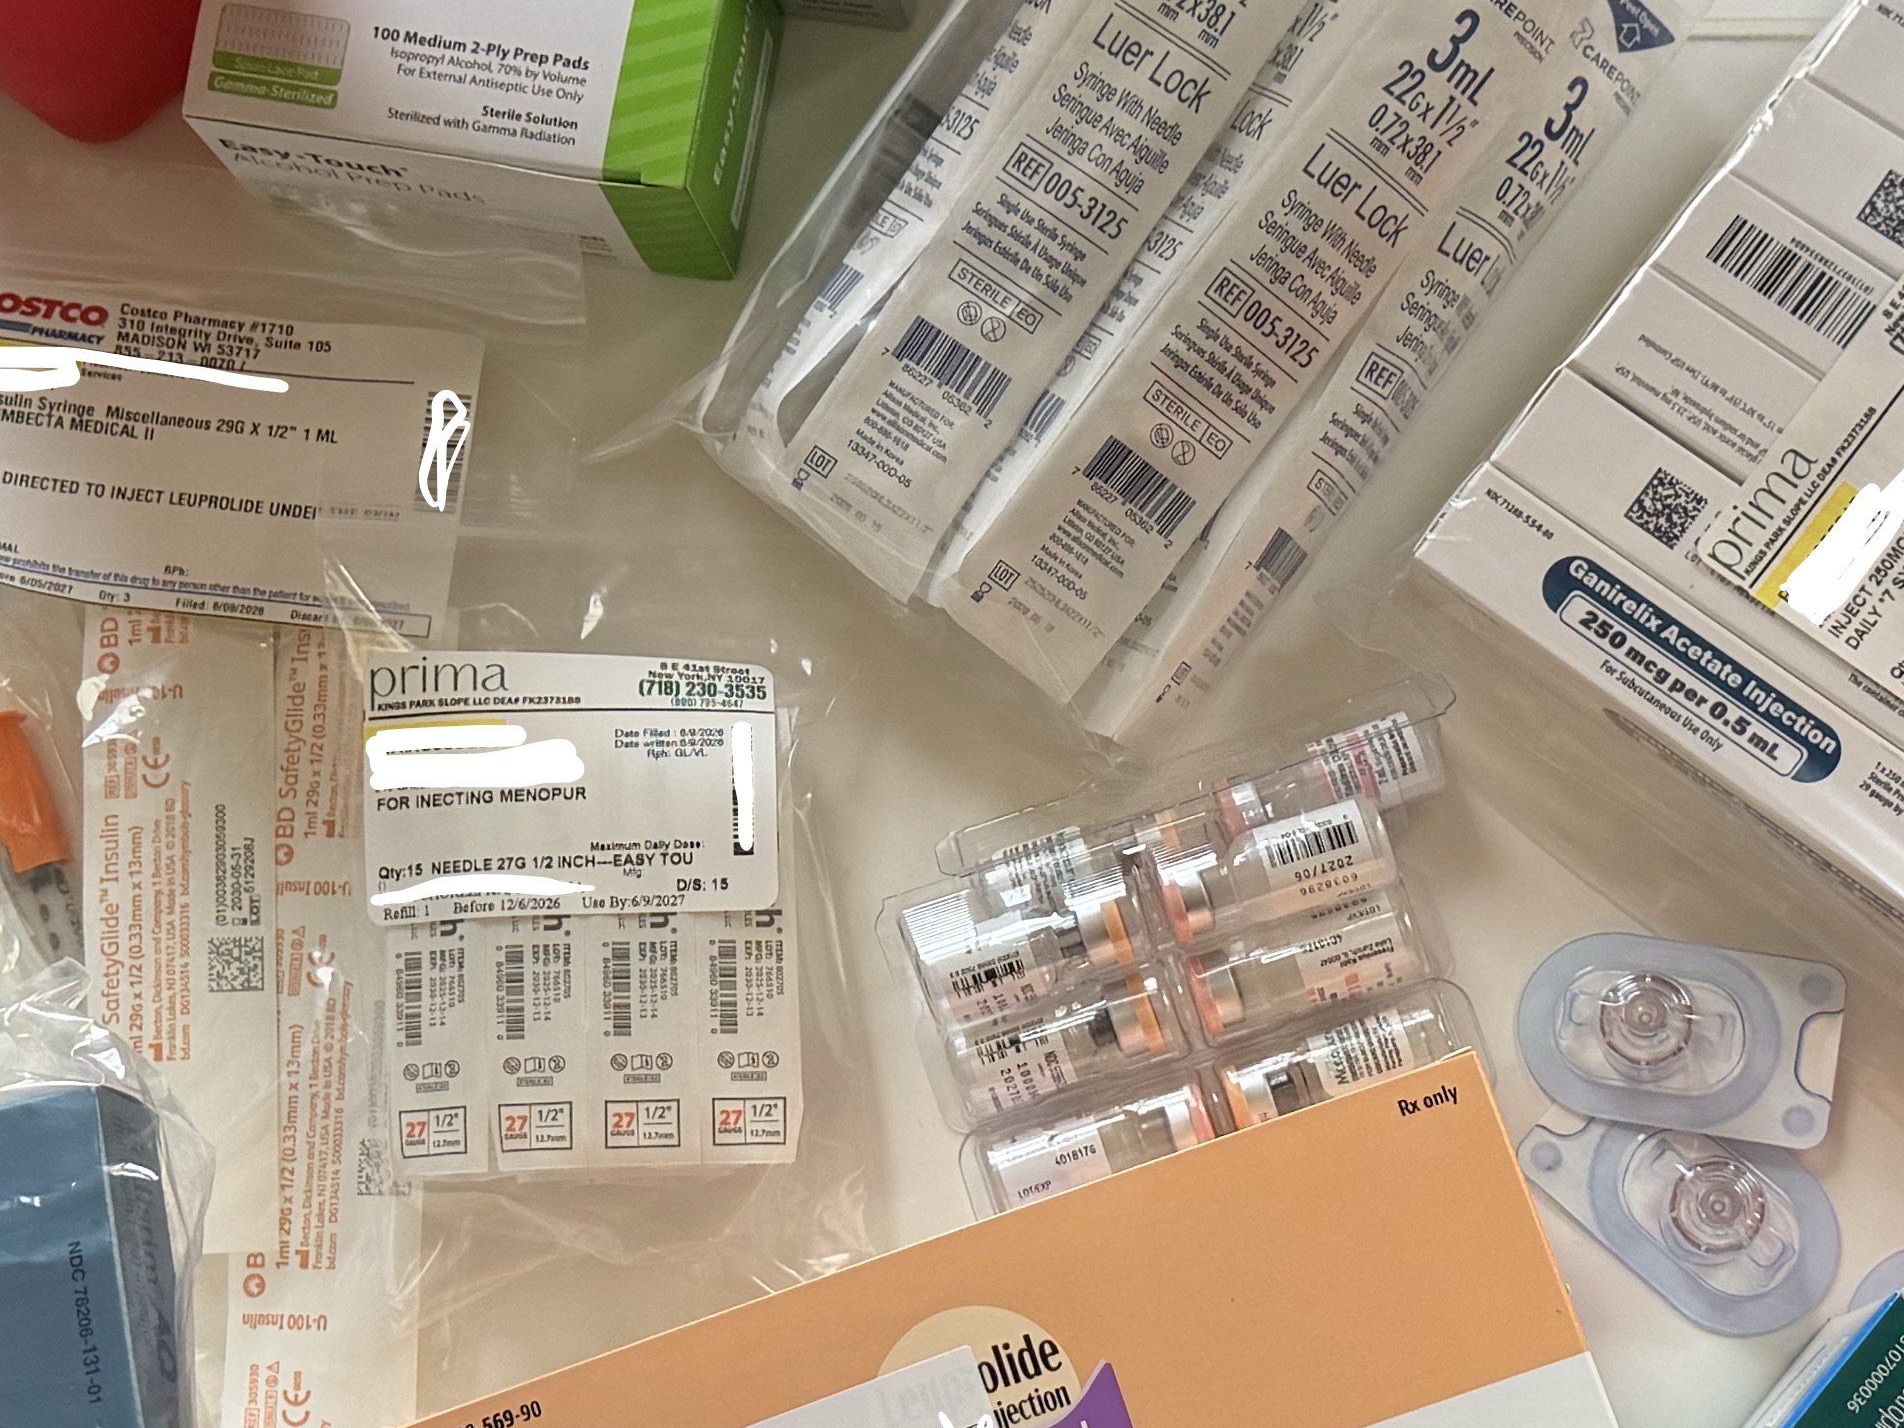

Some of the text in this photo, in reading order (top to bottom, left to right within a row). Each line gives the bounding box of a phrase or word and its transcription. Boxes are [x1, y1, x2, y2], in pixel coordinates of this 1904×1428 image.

[373, 26, 590, 71] 100 Medium 2-Ply Prep Pads
[1092, 12, 1212, 114] Luer Lock
[1074, 62, 1183, 147] Syringe With Needle
[1011, 151, 1129, 241] REF 005-3125
[1301, 143, 1412, 249] Luer Lock
[956, 267, 1037, 327] STERILE EO
[30, 325, 104, 346] PHARMACY
[1213, 278, 1320, 370] REF 005-3125
[1, 470, 80, 495] DIRECTED
[86, 481, 106, 498] TO
[110, 485, 165, 504] INJECT
[168, 491, 264, 515] LEUPROLIDE
[1569, 559, 1837, 754] Ganirelix Acetate Injection
[370, 656, 510, 711] prima
[638, 678, 767, 701] (718) 230-3535
[377, 786, 587, 812] FOR INECTING MENOPUR
[505, 1114, 529, 1132] 27
[1398, 1085, 1459, 1118] Rx only
[405, 1121, 428, 1139] 27
